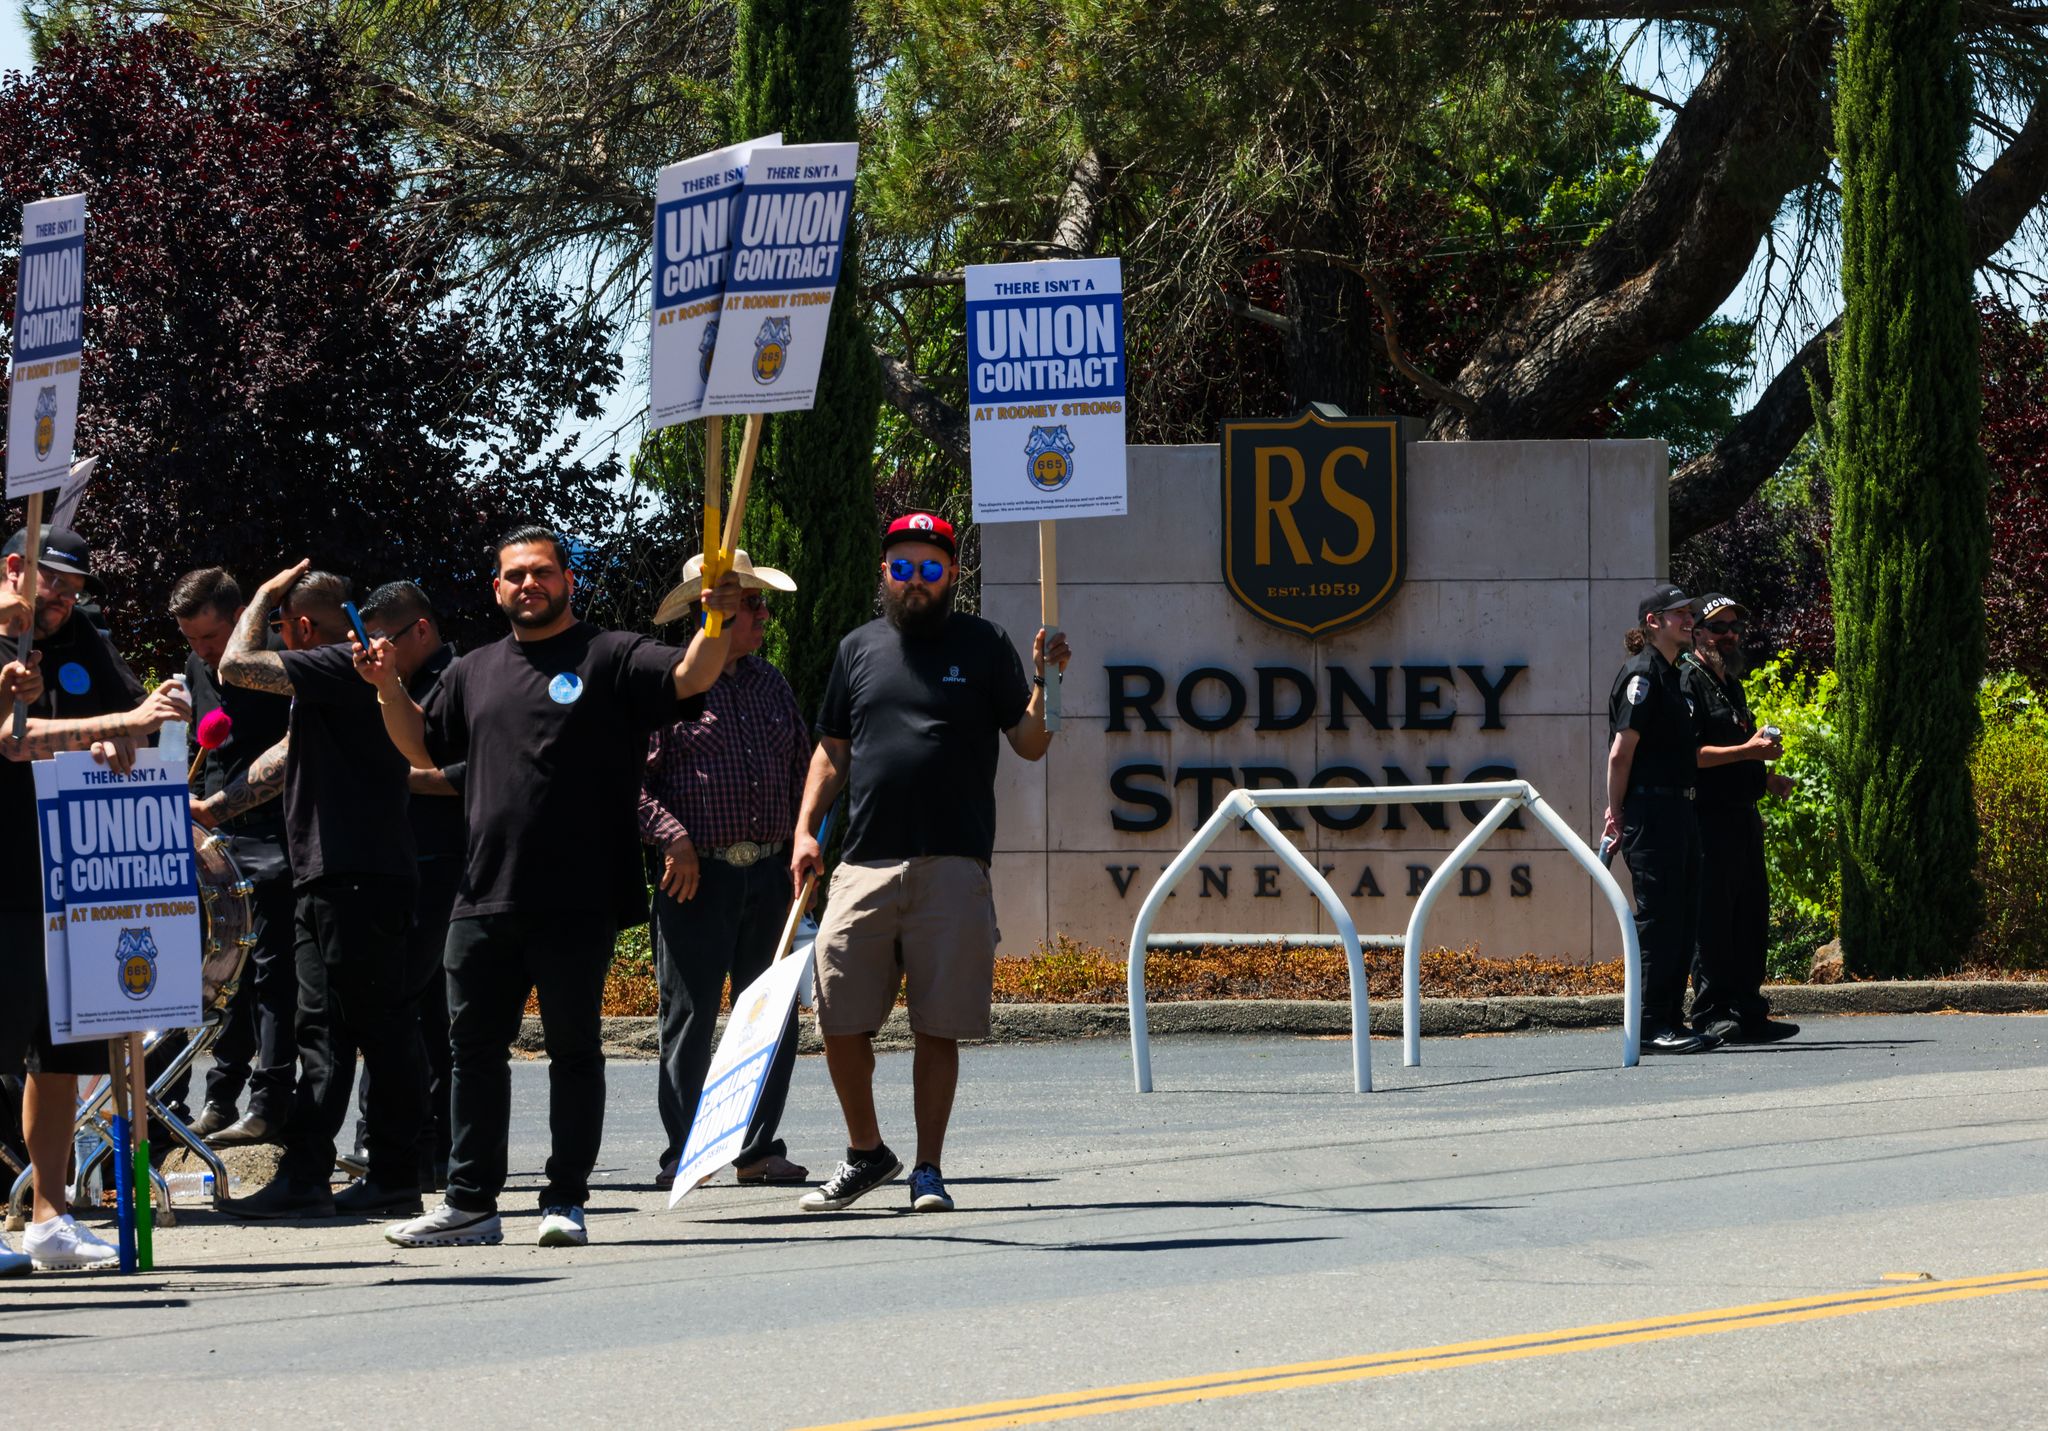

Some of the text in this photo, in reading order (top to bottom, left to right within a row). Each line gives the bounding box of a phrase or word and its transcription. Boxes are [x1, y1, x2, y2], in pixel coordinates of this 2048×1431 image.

[682, 164, 749, 194] THERE ISN
[767, 165, 838, 180] THERE ISN'T A
[35, 222, 56, 238] THERE
[665, 194, 736, 263] UNI
[741, 190, 847, 247] UNION
[23, 246, 82, 312] UNION
[663, 251, 728, 297] CONT
[733, 245, 839, 282] CONTRACT
[725, 291, 832, 310] AT RODNEY STRONG
[995, 278, 1095, 295] THERE ISN'T A
[20, 306, 81, 350] CONTRACT
[658, 310, 677, 326] AT
[976, 303, 1116, 360] UNION
[16, 366, 26, 382] AT
[977, 356, 1118, 394] CONTRACT
[974, 400, 1122, 421] AT RODNEY STRONG
[1038, 459, 1062, 470] 665
[1254, 445, 1376, 566] RS
[1103, 665, 1529, 732] RODNEY
[82, 767, 167, 785] THERE ISN'T A
[1110, 763, 1525, 832] STRONG
[68, 795, 188, 856] UNION
[70, 852, 190, 893] CONTRACT
[1106, 864, 1533, 898] VNEARDS
[71, 900, 197, 922] AT RODNEY STRONG
[127, 965, 147, 976] 665
